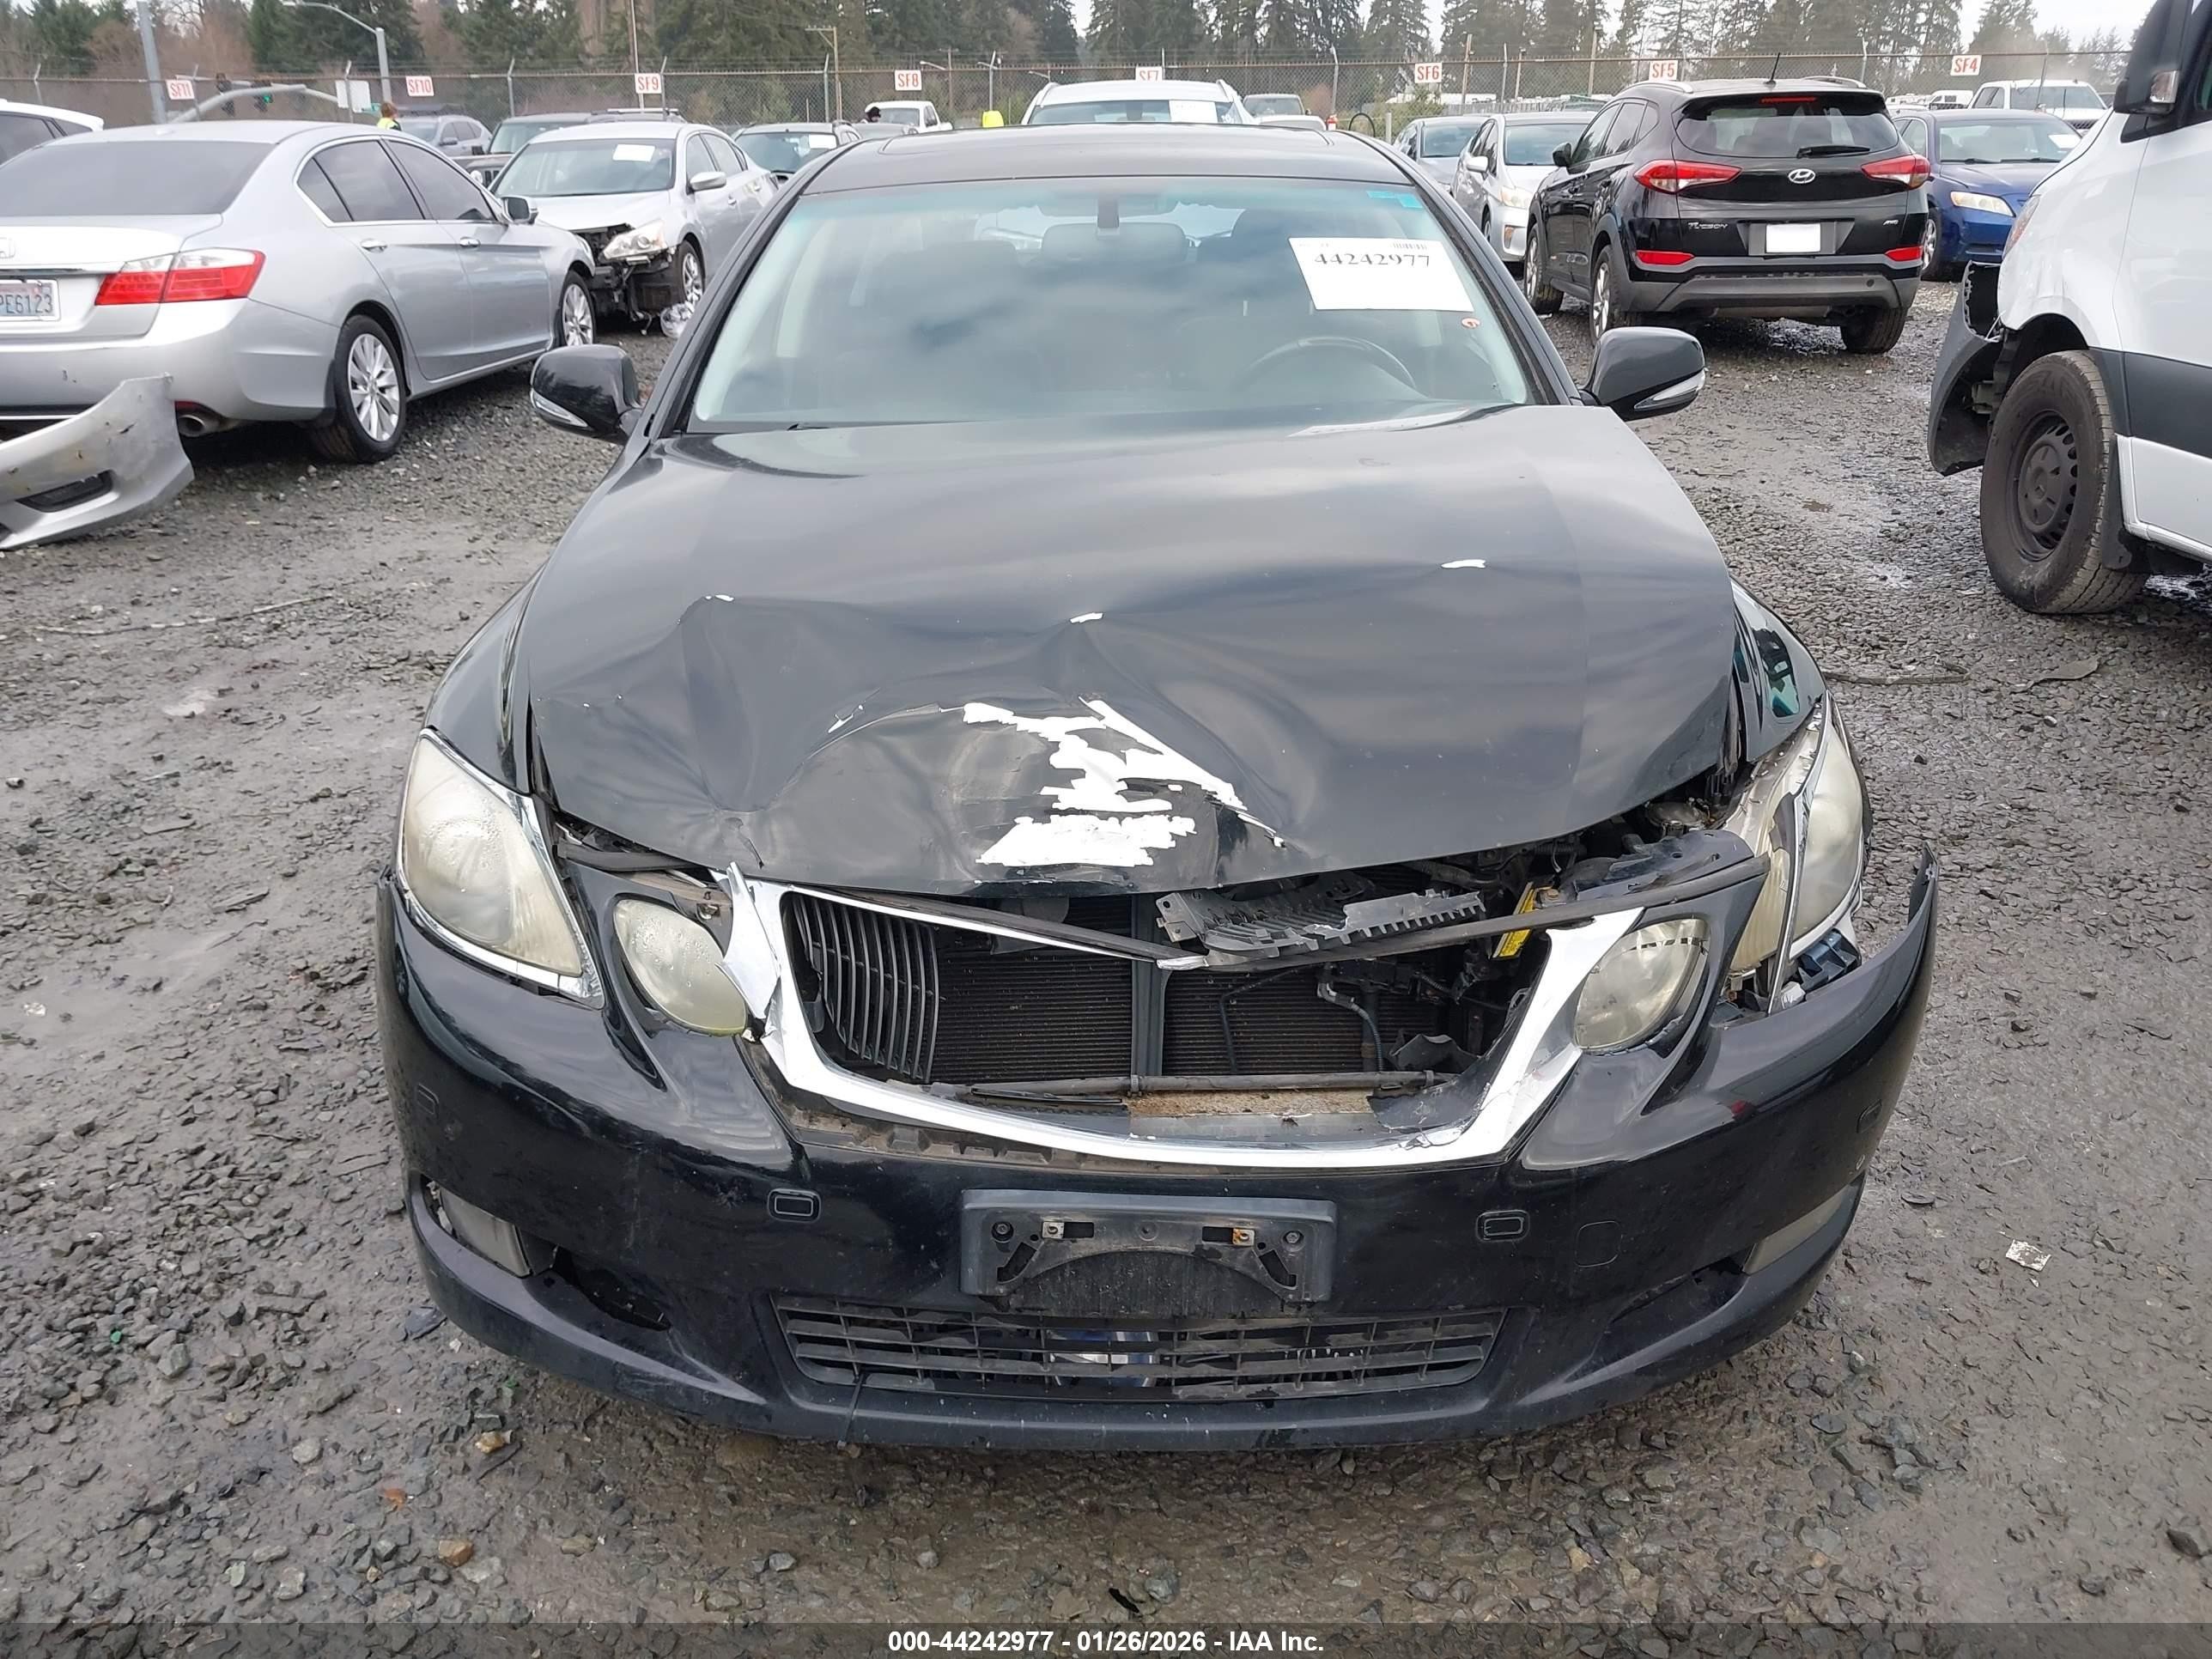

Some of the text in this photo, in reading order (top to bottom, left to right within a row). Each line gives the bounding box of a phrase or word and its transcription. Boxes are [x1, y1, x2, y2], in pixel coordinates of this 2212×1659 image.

[1417, 64, 1440, 81] SF6
[1651, 62, 1675, 79] SF5
[1953, 57, 1978, 74] SF4
[637, 76, 659, 91] SF9
[897, 72, 919, 88] SF8
[1139, 70, 1159, 82] SF7
[171, 82, 191, 97] SF11
[408, 78, 432, 94] SF10
[1314, 252, 1431, 268] 44242977
